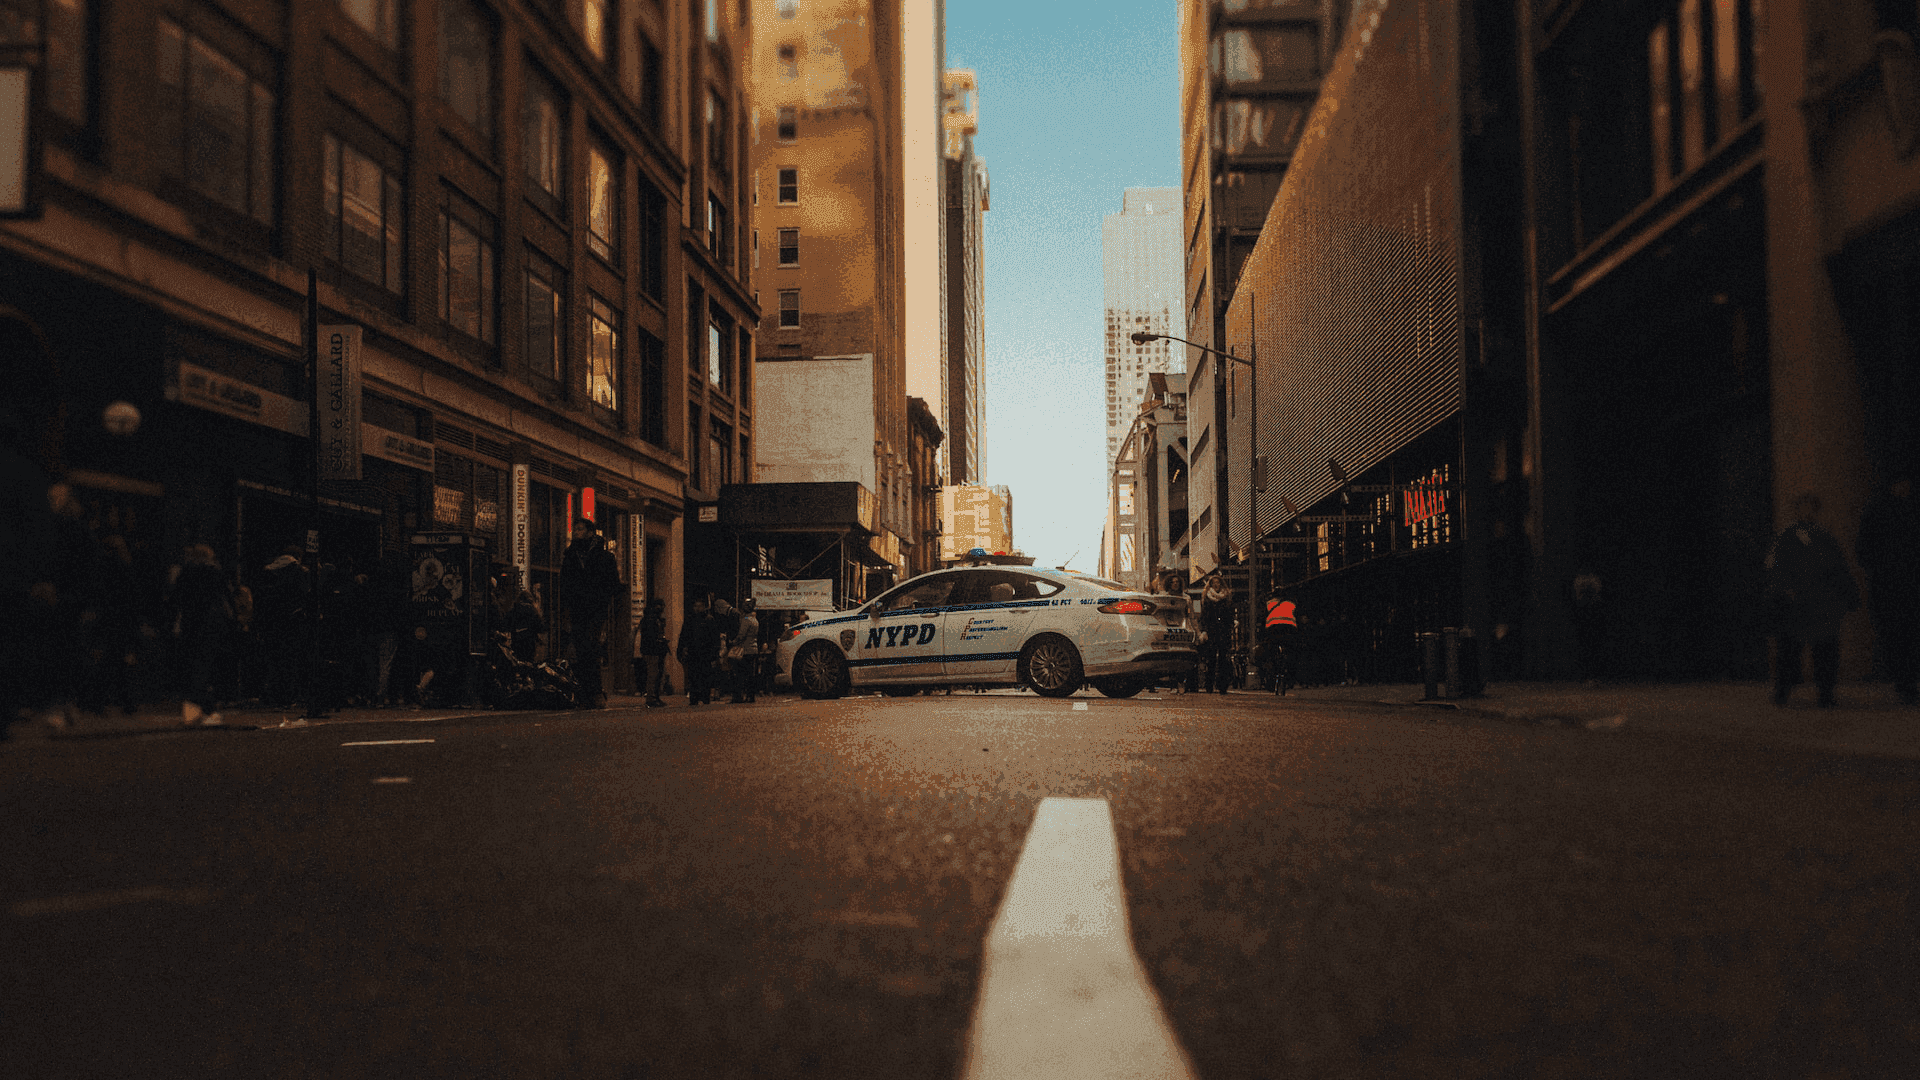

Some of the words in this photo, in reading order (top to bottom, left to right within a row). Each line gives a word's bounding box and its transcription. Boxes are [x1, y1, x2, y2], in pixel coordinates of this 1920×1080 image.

[330, 333, 343, 412] GALLARD
[330, 418, 342, 429] &
[330, 436, 343, 472] GUY
[517, 469, 526, 512] DUNKIN'
[517, 523, 525, 565] DONUTS
[864, 623, 936, 649] NYPD
